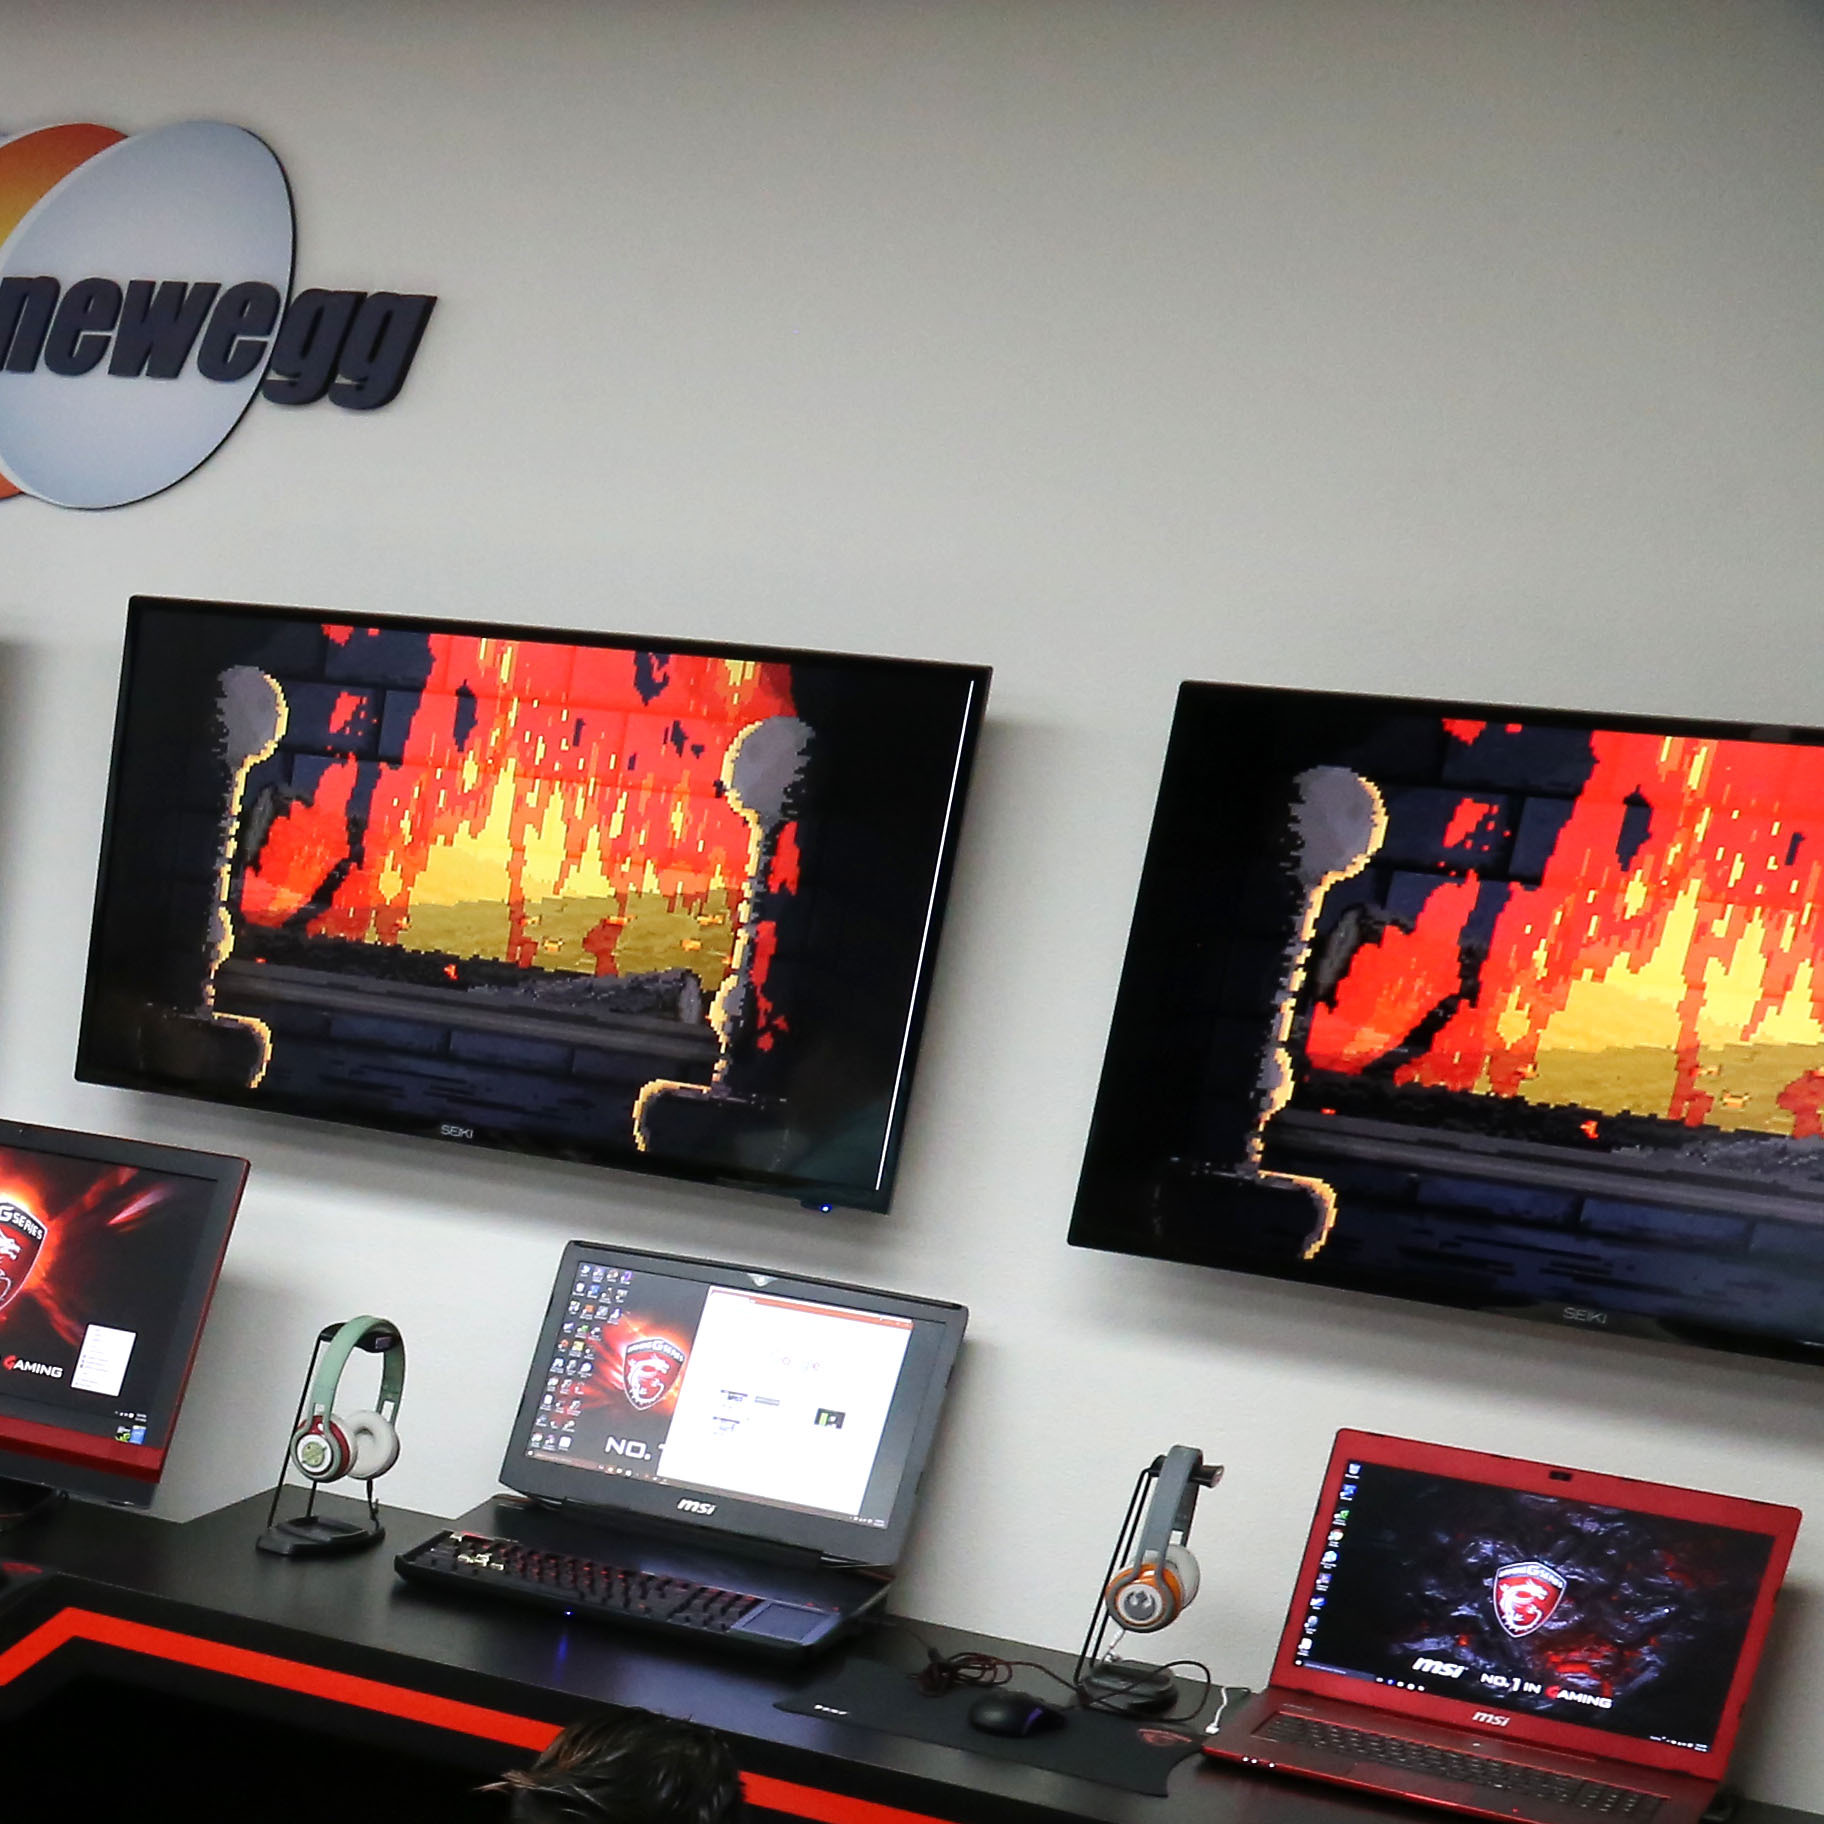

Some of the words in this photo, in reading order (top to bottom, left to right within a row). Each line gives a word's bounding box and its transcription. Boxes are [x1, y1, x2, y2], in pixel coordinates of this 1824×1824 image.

[2, 1355, 64, 1379] GAMING
[677, 1499, 715, 1515] msi
[1412, 1657, 1466, 1679] msi
[1522, 1682, 1542, 1694] IN
[1544, 1685, 1612, 1709] GAMING
[1471, 1711, 1512, 1727] msi
